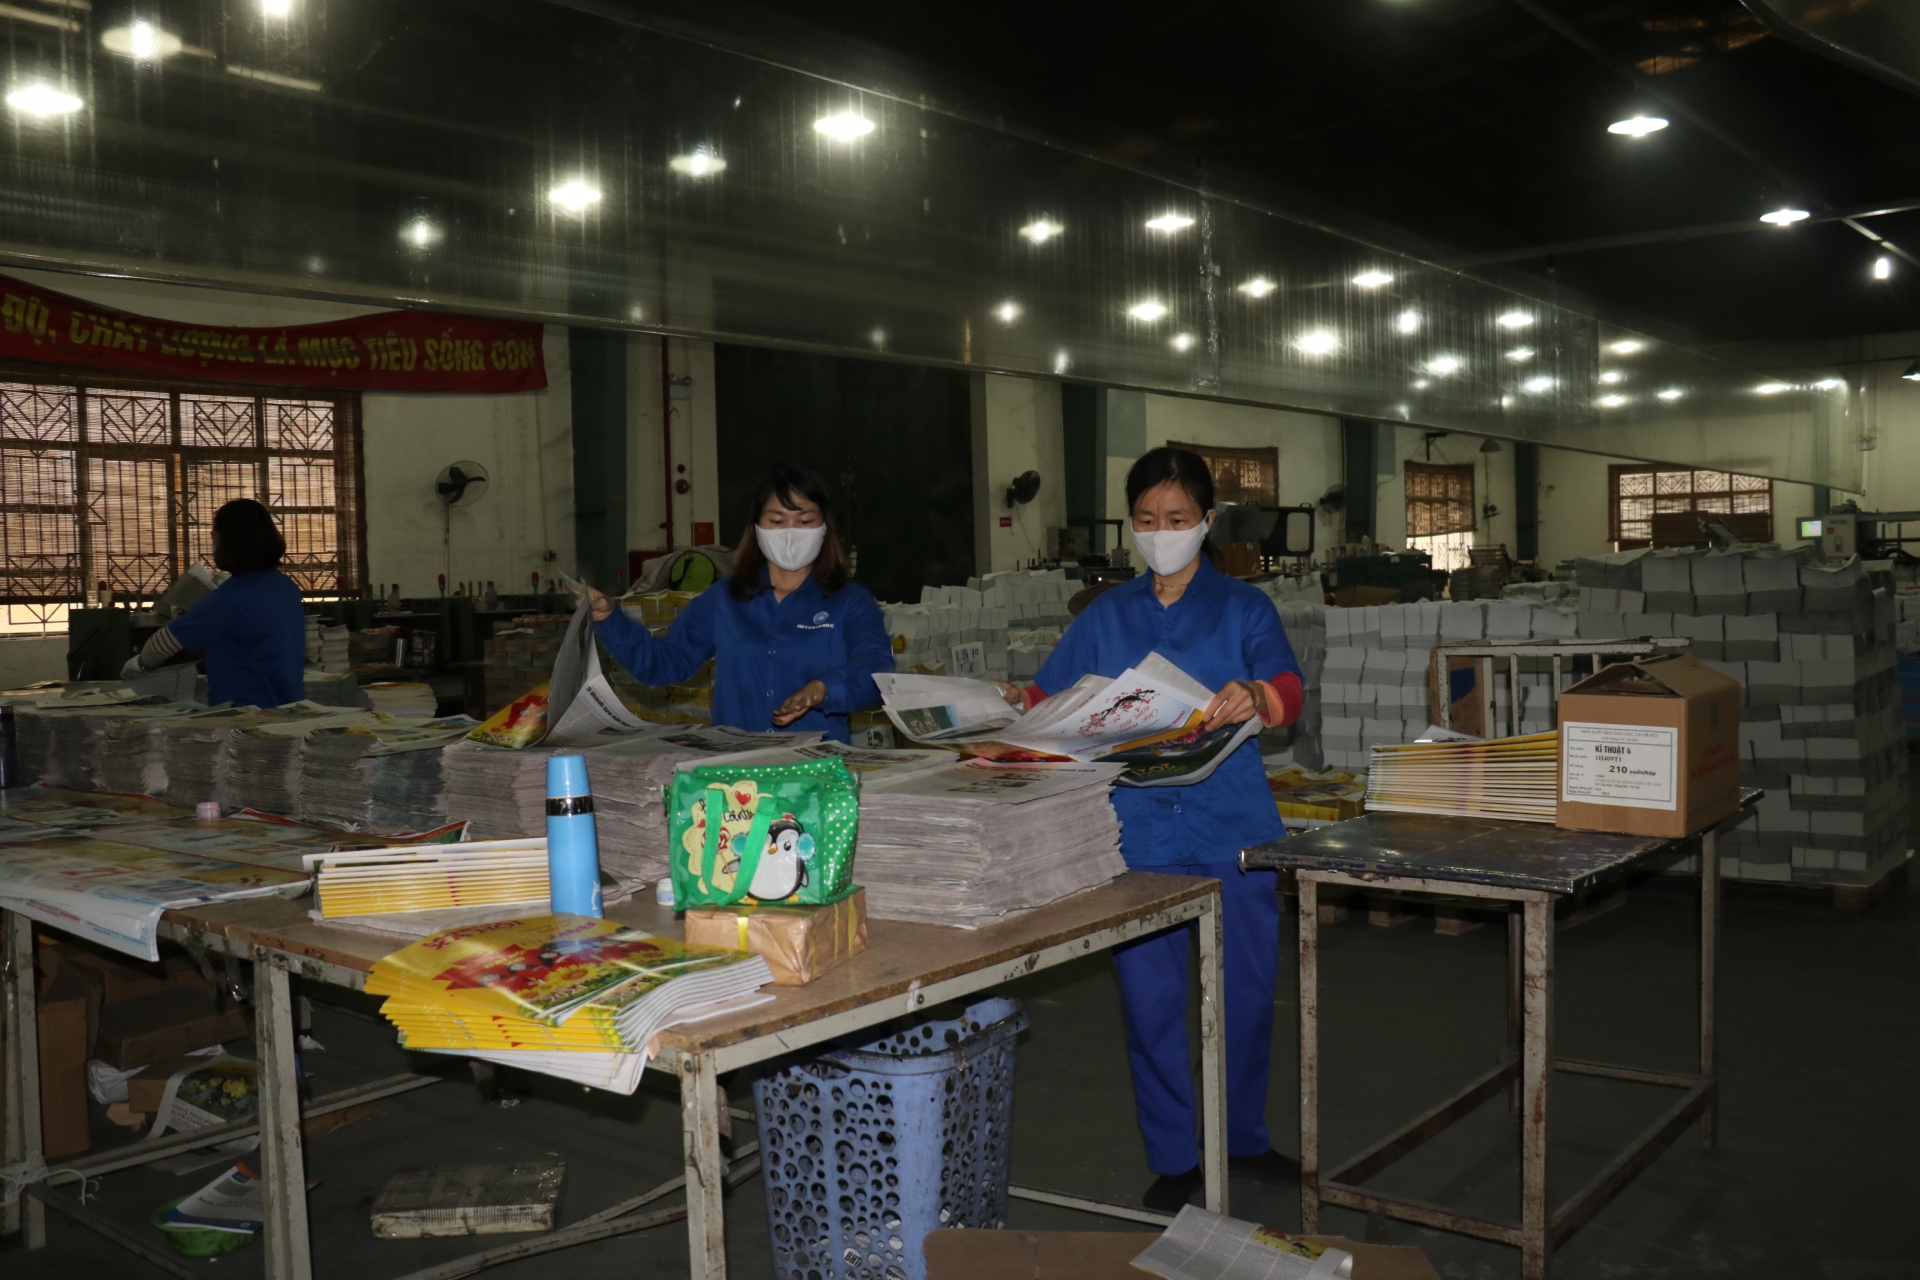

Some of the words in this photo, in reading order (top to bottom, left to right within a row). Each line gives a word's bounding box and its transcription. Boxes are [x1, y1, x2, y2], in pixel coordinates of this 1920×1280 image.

[363, 330, 418, 372] TIÊU
[423, 326, 486, 372] SỐNG
[1604, 745, 1625, 755] THUẬT
[1609, 765, 1628, 774] 210
